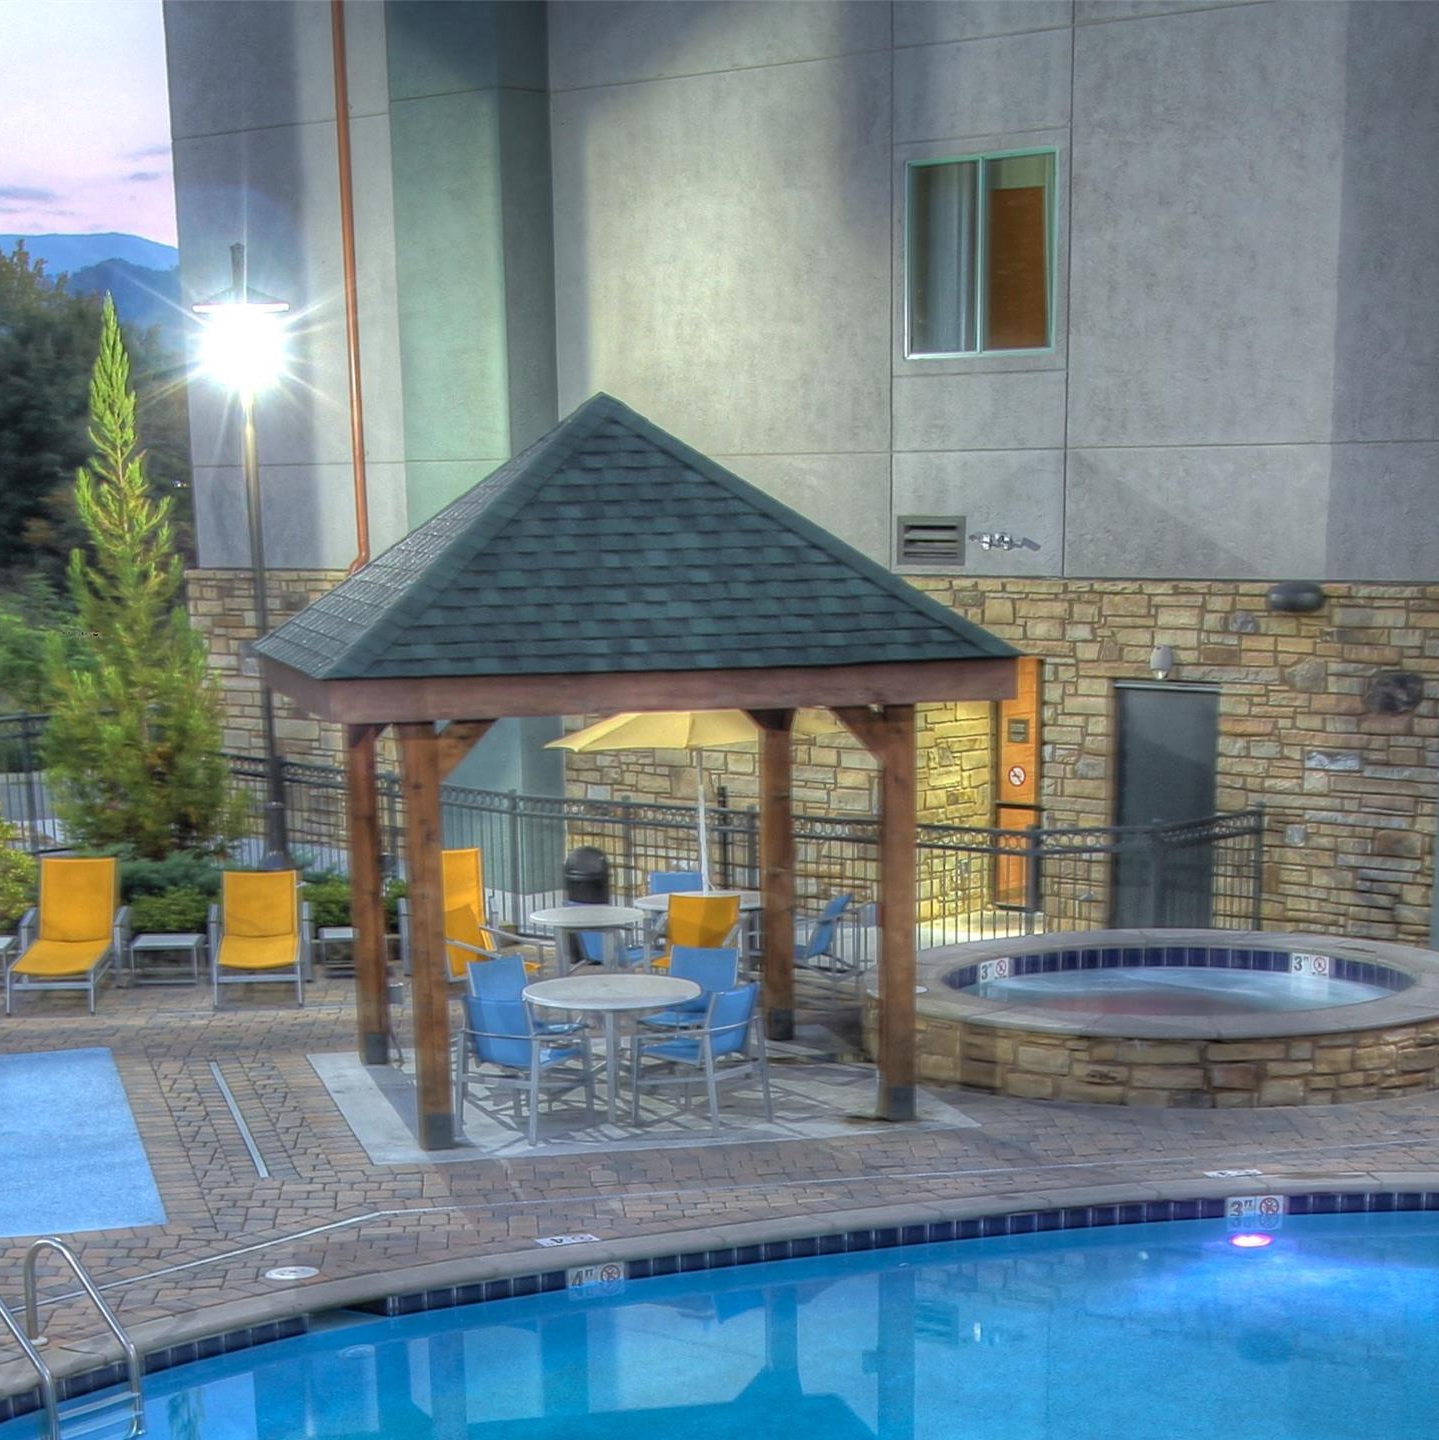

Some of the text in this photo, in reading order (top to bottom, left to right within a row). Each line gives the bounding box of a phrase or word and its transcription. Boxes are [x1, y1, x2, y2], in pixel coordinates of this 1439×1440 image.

[981, 964, 989, 980] 3
[1293, 955, 1303, 972] 3
[571, 1270, 584, 1287] 4
